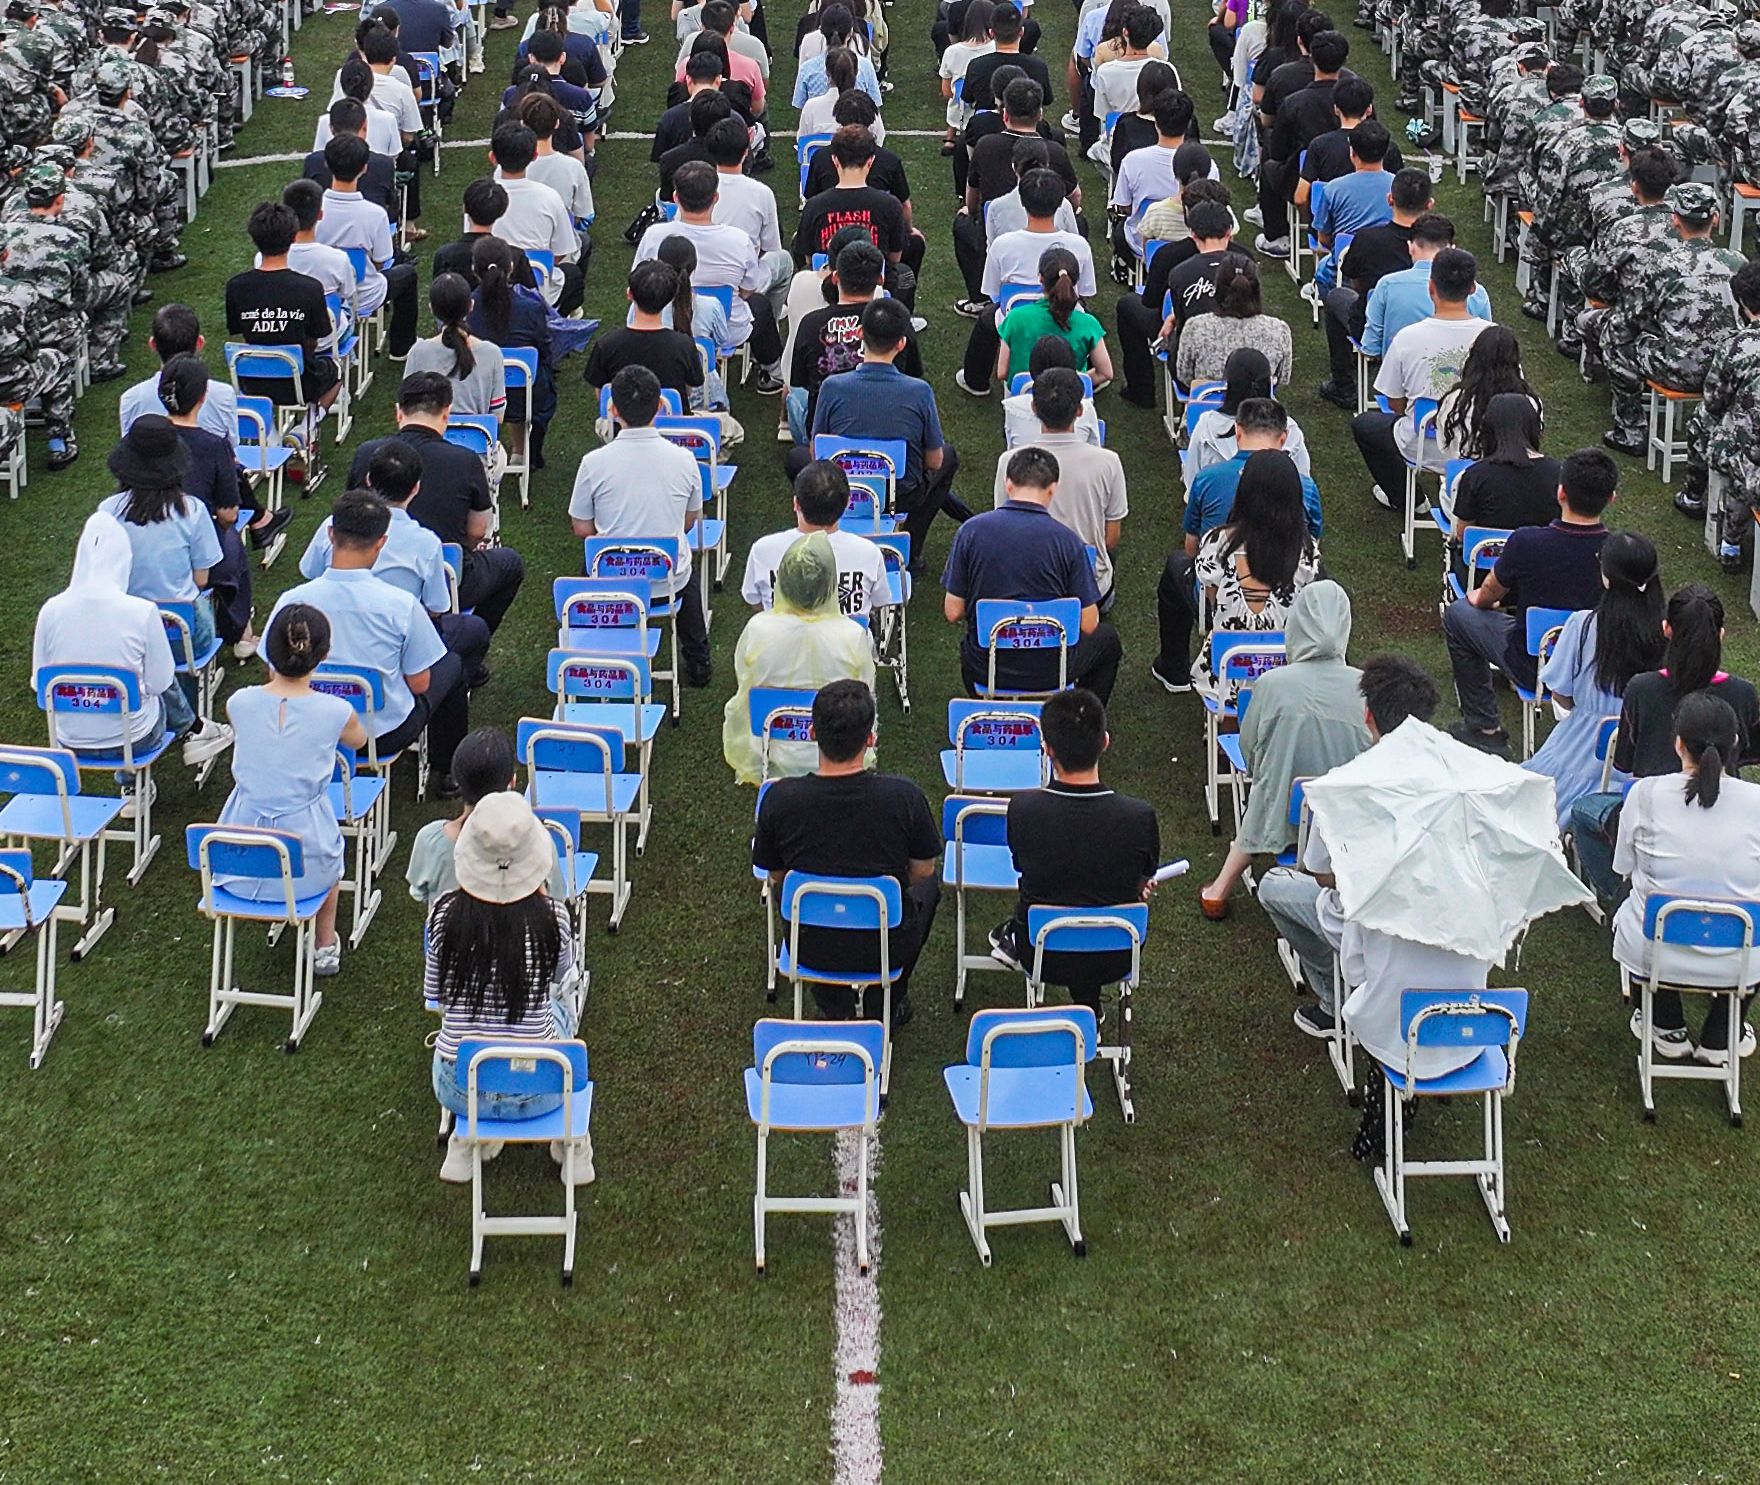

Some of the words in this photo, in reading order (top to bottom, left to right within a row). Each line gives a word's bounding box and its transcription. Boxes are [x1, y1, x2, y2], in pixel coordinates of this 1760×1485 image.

[827, 210, 871, 224] FLASH
[261, 308, 274, 319] de
[276, 307, 288, 319] la
[289, 309, 305, 321] vie
[251, 320, 289, 333] ADLV
[605, 556, 661, 567] 食品与药品系
[619, 567, 647, 577] 304
[575, 602, 634, 614] 食品与药品系
[591, 615, 620, 625] 304
[997, 627, 1056, 639] 食品与药品系
[1012, 639, 1041, 648] 304
[568, 668, 628, 681] 食品与药品系
[310, 683, 362, 696] 品与药品系
[583, 679, 612, 690] 304
[57, 685, 117, 699] 食品与药品系
[71, 698, 101, 708] 304
[971, 723, 1033, 736] 食品与药品系
[986, 736, 1017, 746] 304
